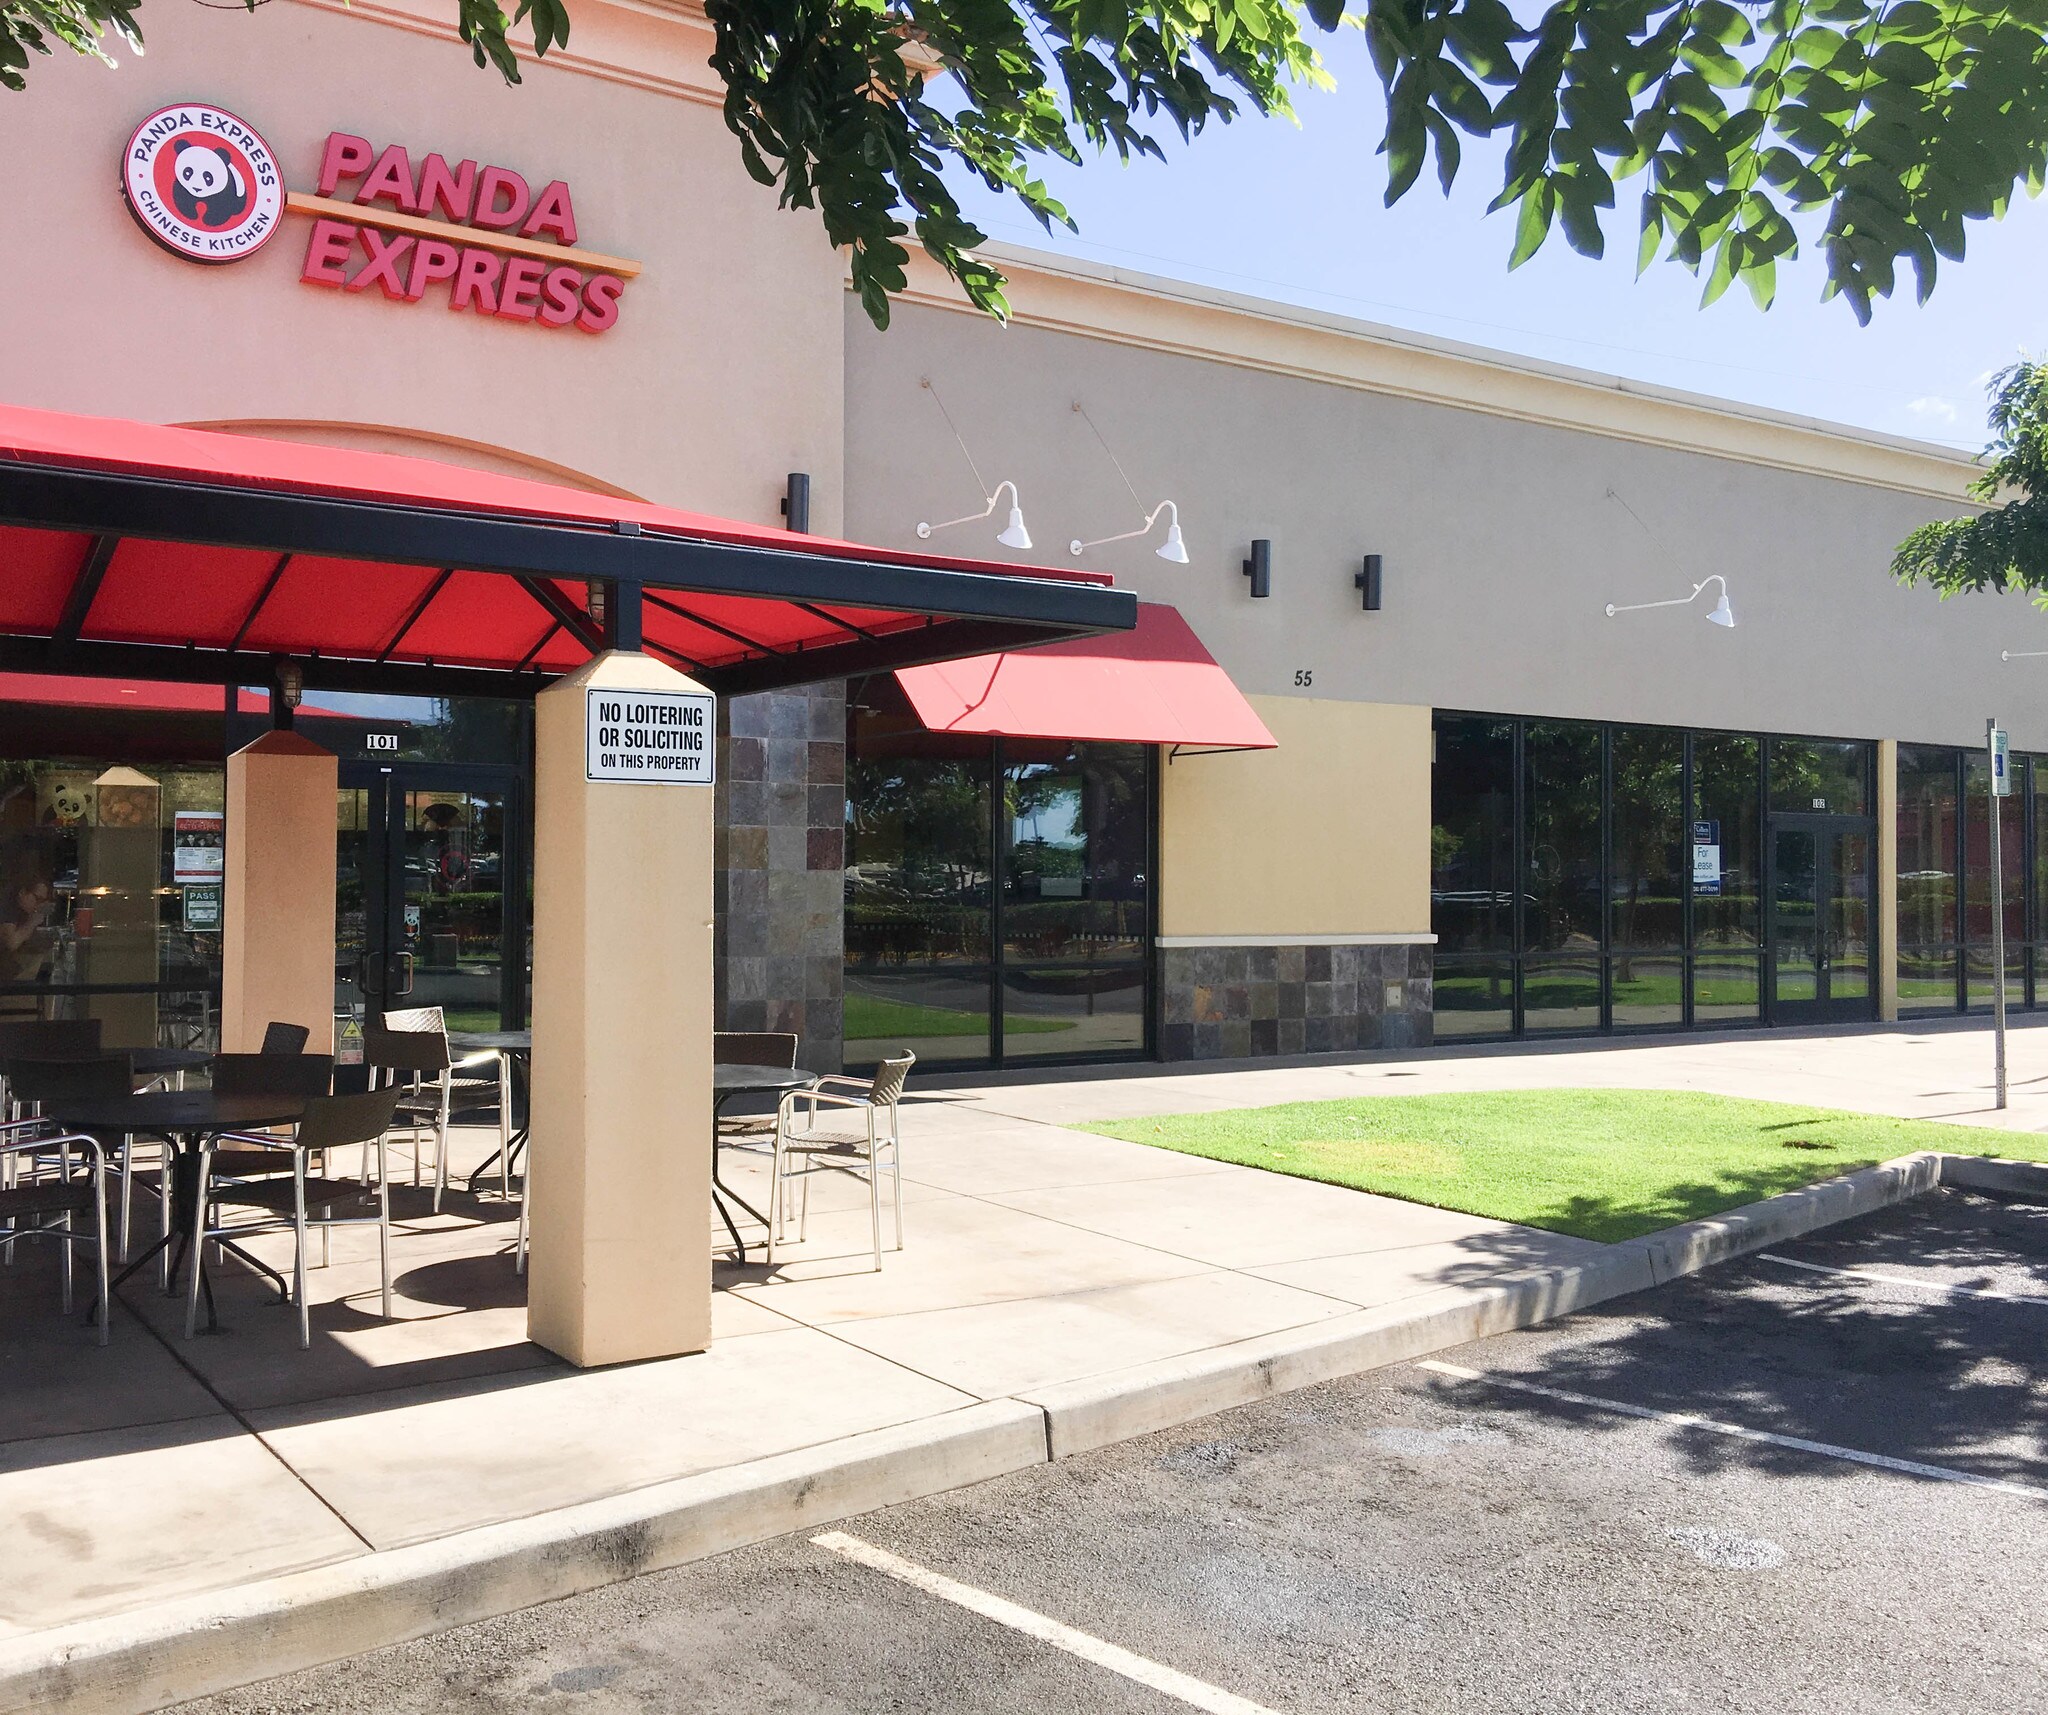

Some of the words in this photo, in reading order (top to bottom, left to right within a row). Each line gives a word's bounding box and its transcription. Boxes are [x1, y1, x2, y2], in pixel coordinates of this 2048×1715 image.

[134, 112, 194, 163] PANDA
[199, 113, 276, 187] EXPRESS
[314, 131, 578, 246] PANDA
[138, 189, 202, 248] CHINESE
[208, 211, 271, 251] KITCHEN
[299, 219, 625, 335] EXPRESS
[1294, 670, 1312, 687] 55
[599, 702, 621, 723] NO
[626, 703, 703, 727] LOITERING
[369, 735, 395, 749] 101
[599, 727, 619, 747] OR
[624, 728, 703, 751] SOLICITING
[601, 753, 616, 768] ON
[619, 754, 644, 769] THIS
[647, 755, 701, 771] PROPERTY
[1697, 846, 1709, 858] For
[1693, 859, 1713, 871] Lease
[189, 892, 216, 900] PASS
